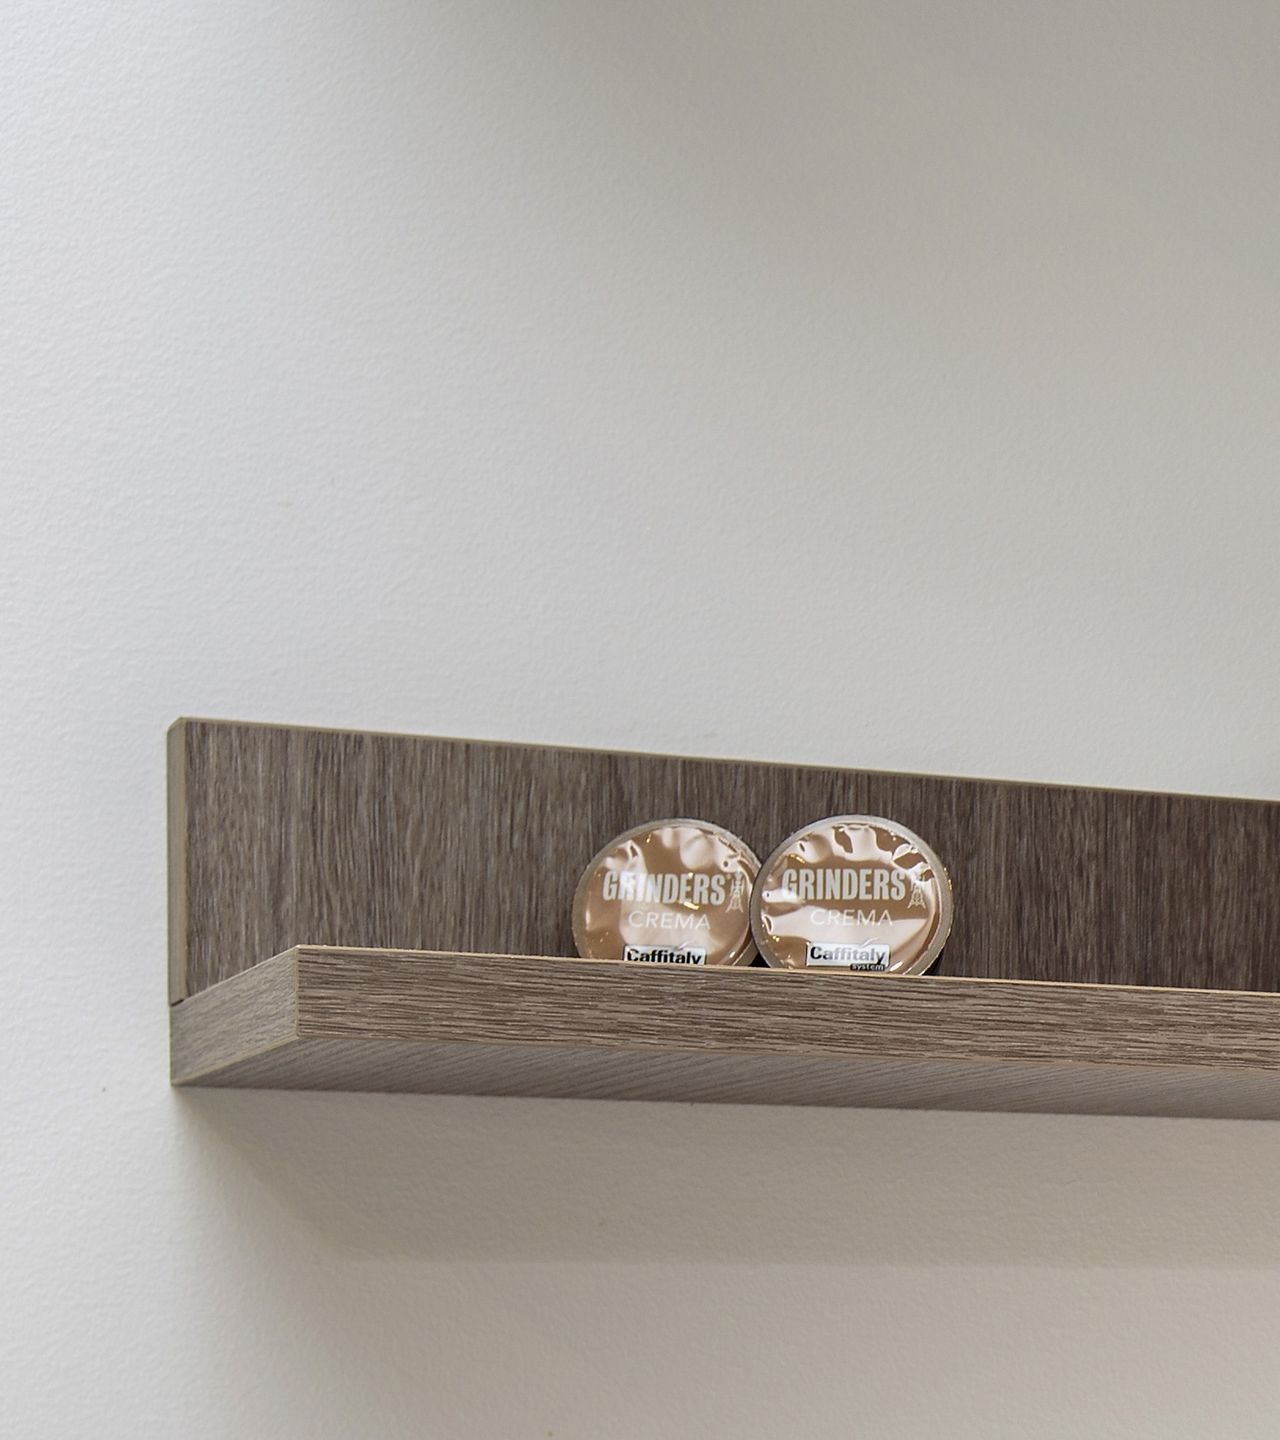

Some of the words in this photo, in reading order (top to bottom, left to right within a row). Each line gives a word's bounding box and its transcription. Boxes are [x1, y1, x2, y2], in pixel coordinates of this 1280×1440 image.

[602, 870, 726, 906] GRINDERS
[782, 868, 906, 901] GRINDERS
[627, 910, 711, 931] CREMA
[809, 908, 894, 926] CREMA
[809, 946, 887, 965] Caffitaly
[851, 963, 885, 971] system
